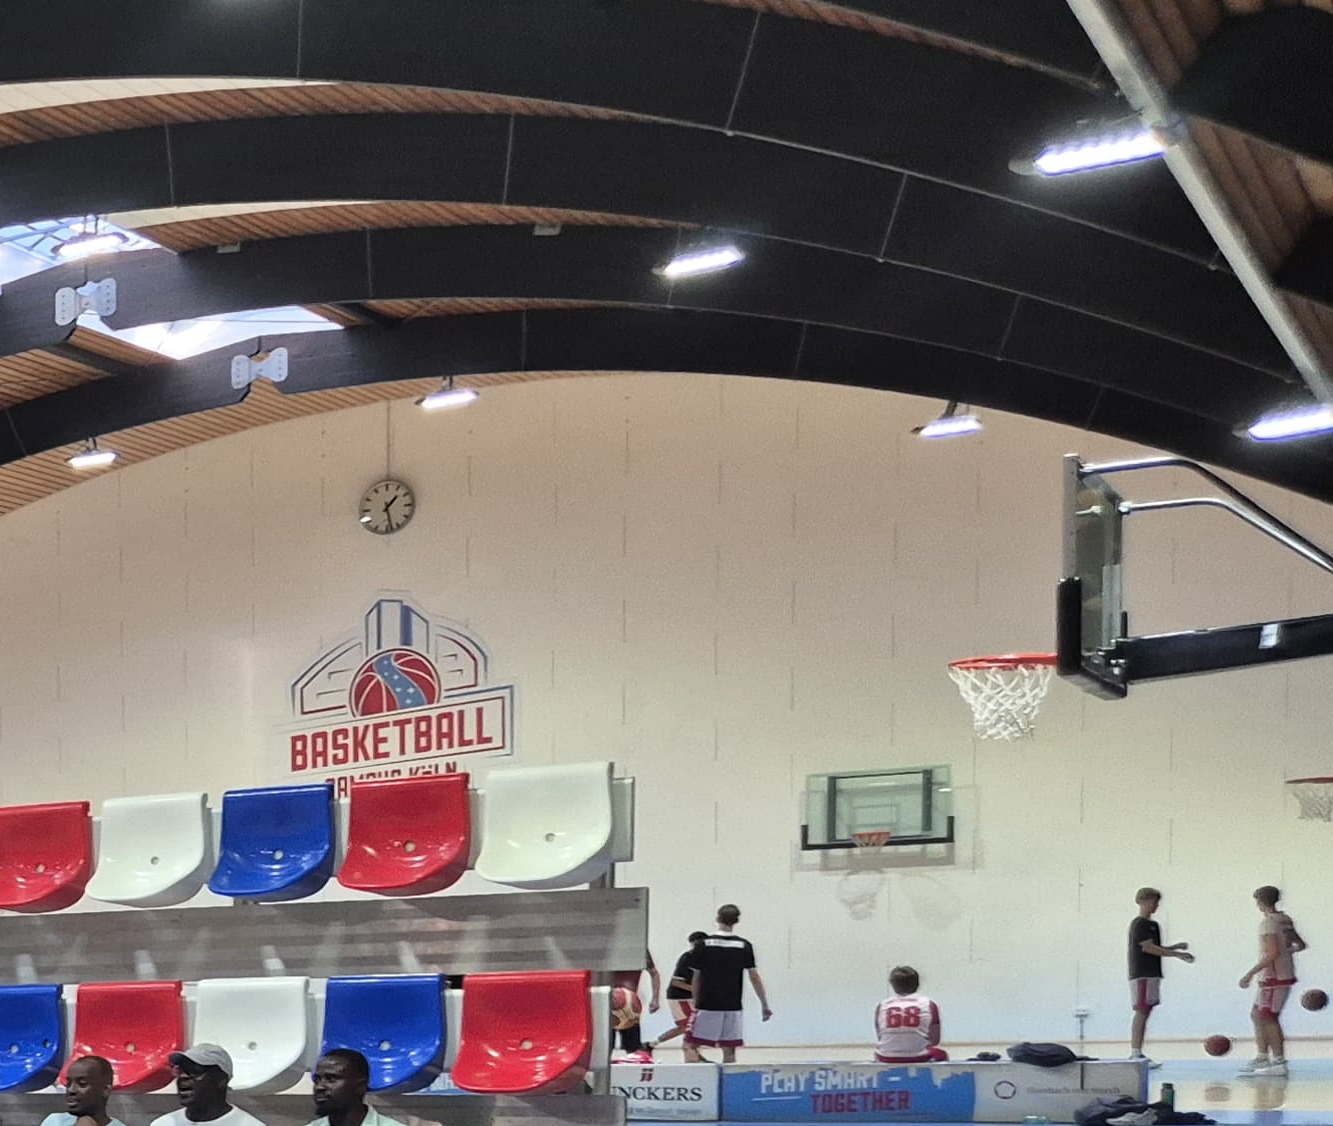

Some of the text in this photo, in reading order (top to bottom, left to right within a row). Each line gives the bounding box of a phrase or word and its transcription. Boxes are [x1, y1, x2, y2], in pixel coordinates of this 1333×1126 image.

[290, 706, 494, 773] BASKETBALL
[885, 1006, 921, 1028] 68
[612, 1086, 703, 1101] NCKERS
[810, 1090, 911, 1114] TOGETHER
